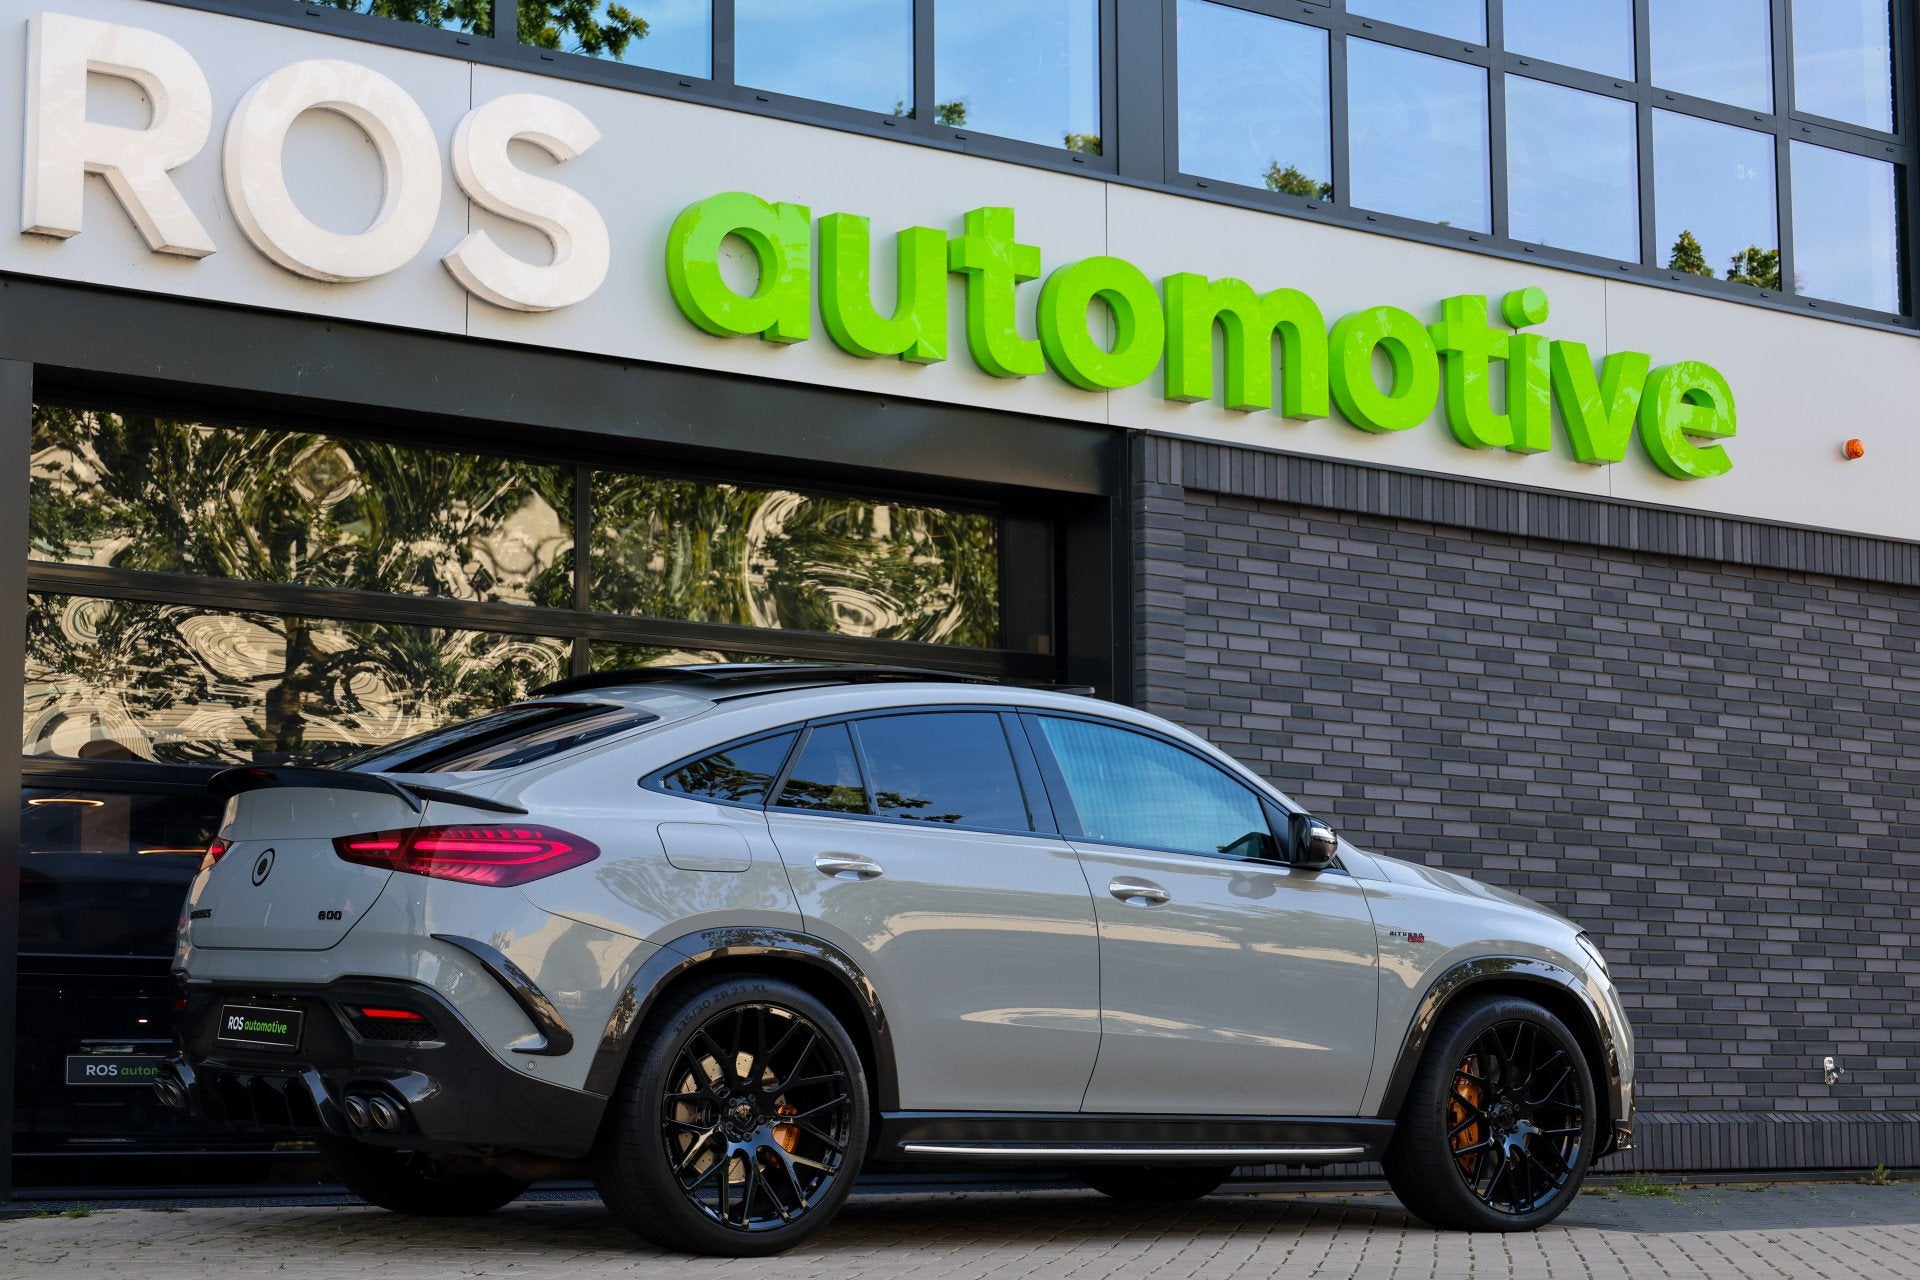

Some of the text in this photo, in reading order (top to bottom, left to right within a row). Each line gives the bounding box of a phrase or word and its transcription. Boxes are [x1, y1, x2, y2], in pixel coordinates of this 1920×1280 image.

[21, 11, 1737, 480] ROS automotive
[227, 1015, 287, 1033] ROS automotive
[85, 1064, 118, 1076] ROS
